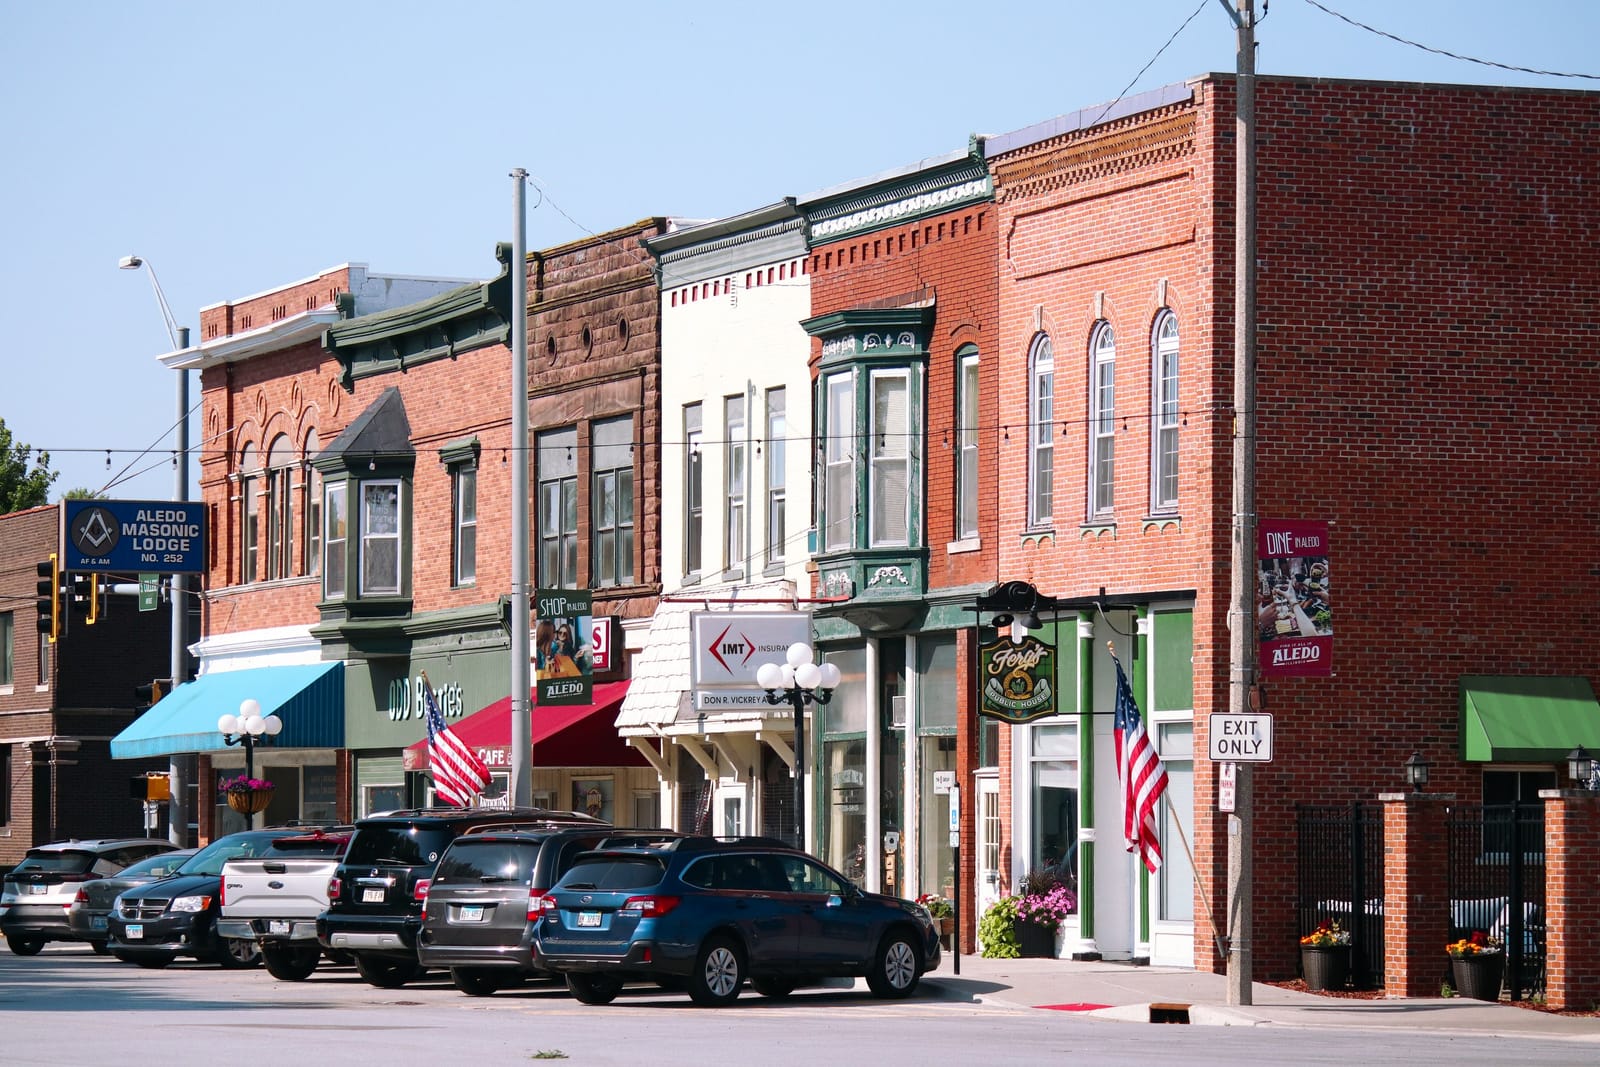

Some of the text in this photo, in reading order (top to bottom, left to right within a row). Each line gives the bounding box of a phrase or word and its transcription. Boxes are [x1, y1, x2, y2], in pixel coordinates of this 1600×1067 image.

[136, 509, 187, 522] ALEDO
[122, 523, 200, 537] MASONIC
[132, 538, 190, 551] LODGE
[1266, 532, 1320, 555] DINE IN ALEDO
[141, 554, 183, 563] NO. 252
[540, 597, 567, 616] SHOP
[571, 602, 588, 610] ALEDO
[722, 644, 789, 655] IMT INSURA
[1272, 645, 1320, 663] ALEDO
[988, 643, 1048, 677] Ferg's
[546, 683, 584, 697] ALEDO
[389, 676, 463, 720] ODD Brie's
[704, 696, 721, 704] DON
[730, 696, 761, 704] VICKREY
[990, 691, 1047, 708] PUBLIC HOUSE
[1224, 720, 1257, 735] EXIT
[1218, 739, 1262, 755] ONLY
[478, 748, 505, 765] CAFE
